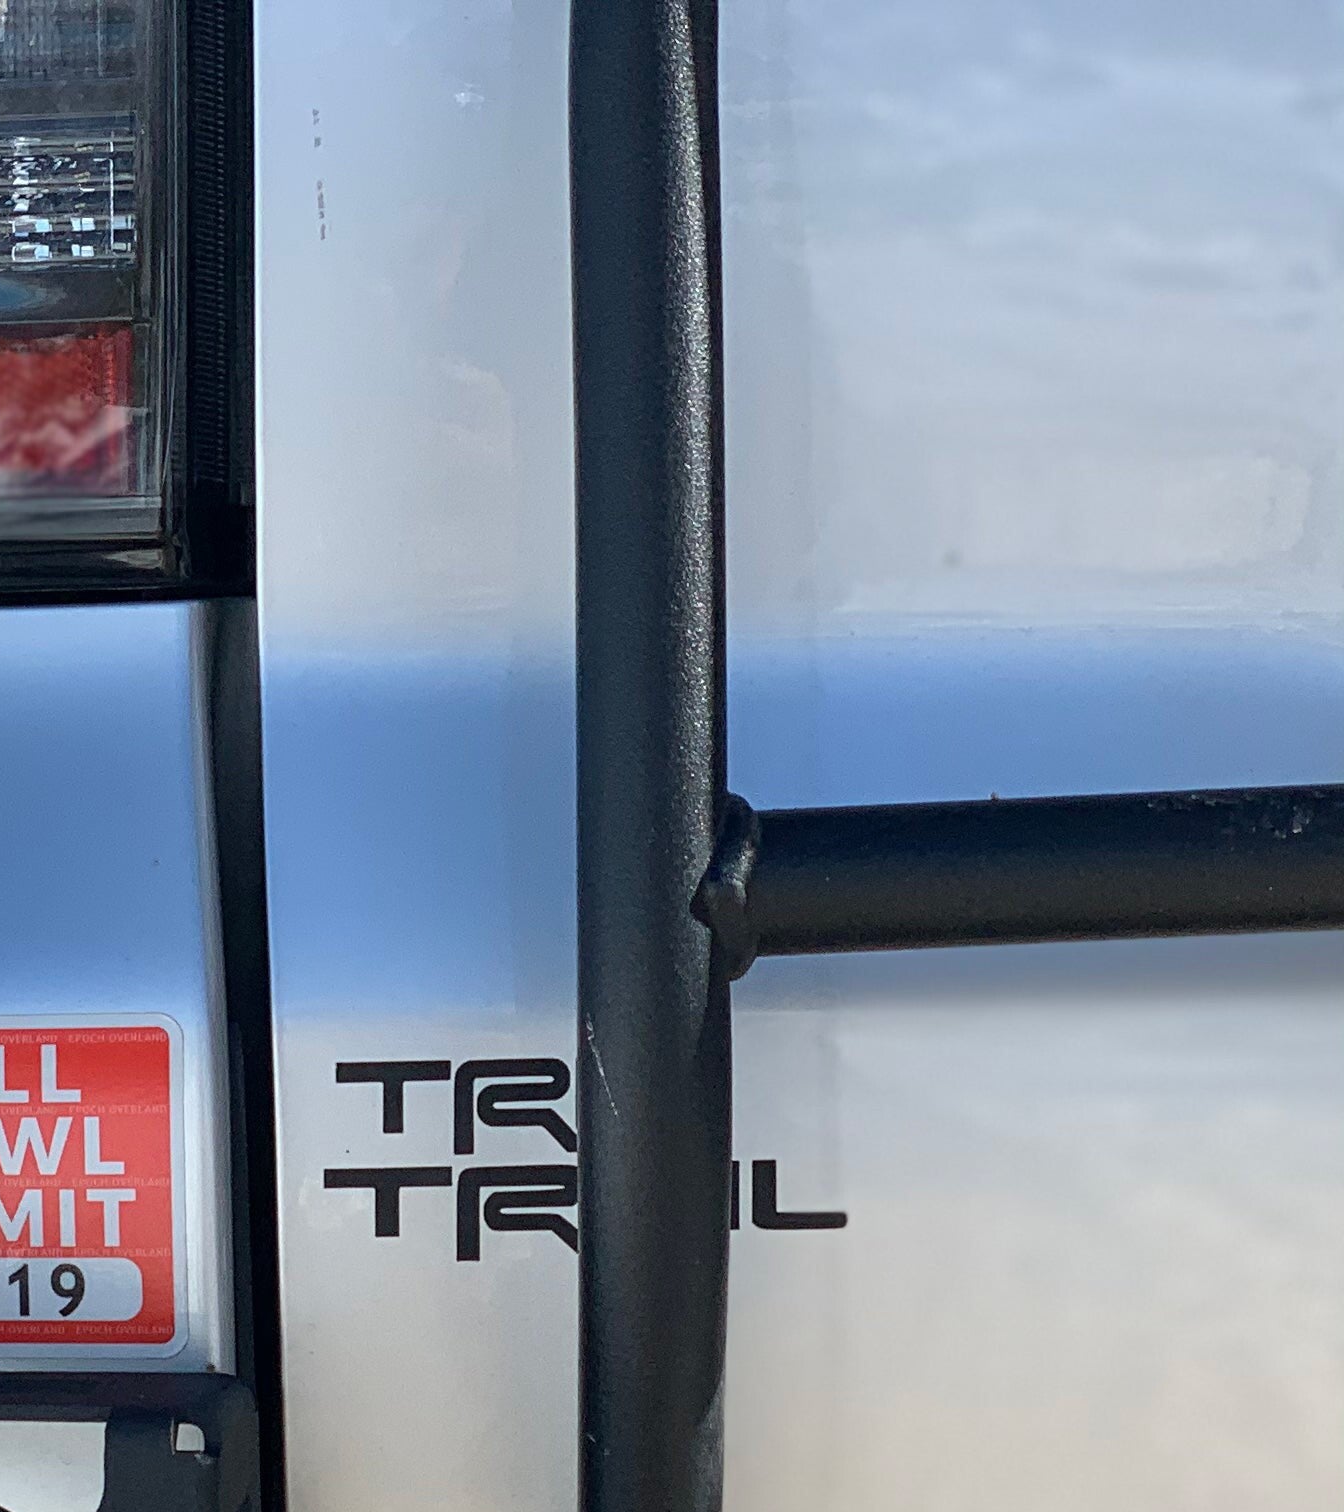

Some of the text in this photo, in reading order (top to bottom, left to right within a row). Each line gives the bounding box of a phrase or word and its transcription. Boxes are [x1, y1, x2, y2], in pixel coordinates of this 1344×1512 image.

[0, 1034, 58, 1045] OVERLAND
[68, 1032, 105, 1043] EPOCH
[108, 1032, 167, 1043] OVERLAND
[323, 1159, 848, 1262] TRL
